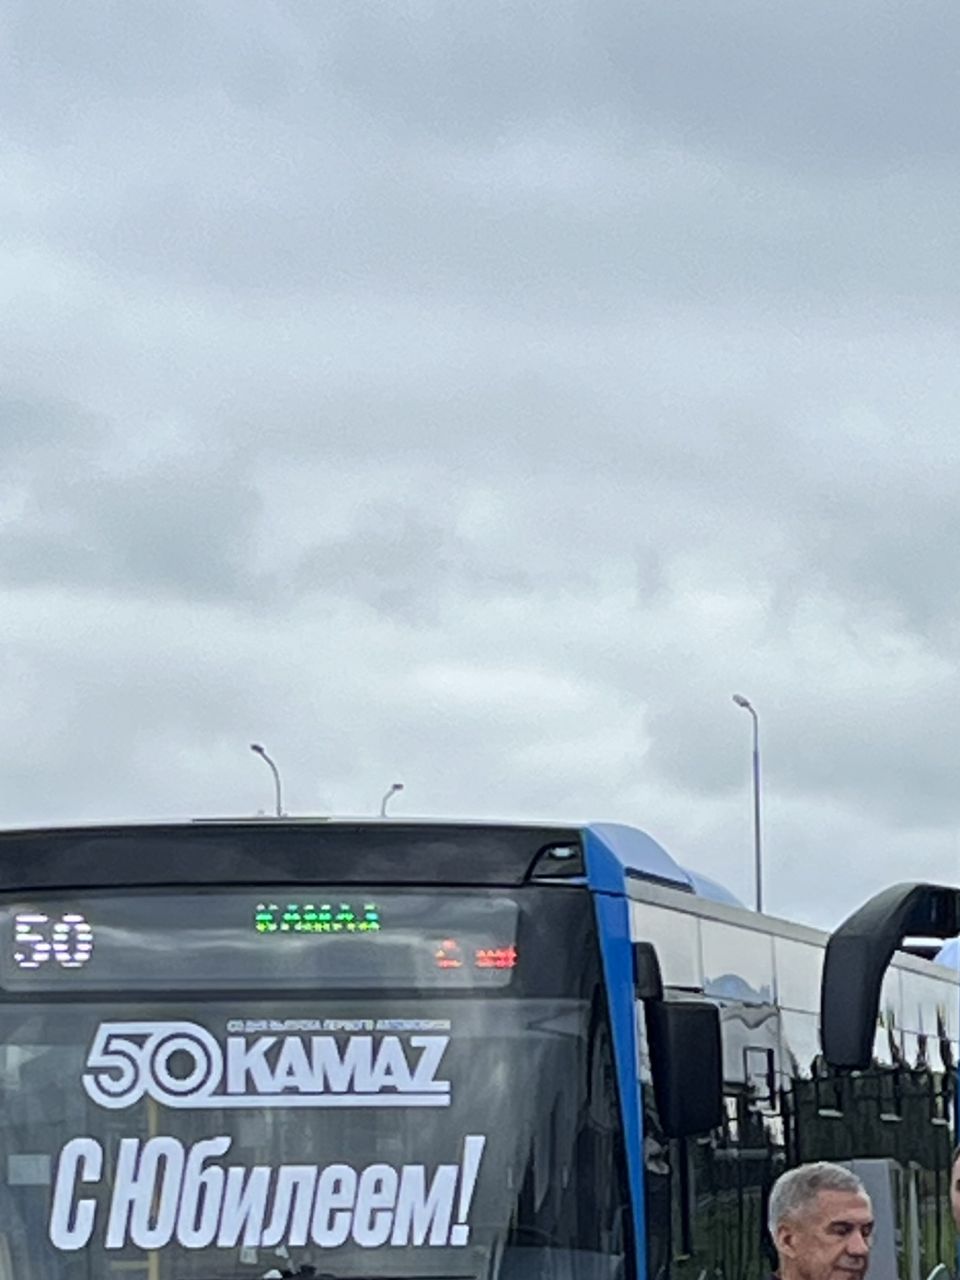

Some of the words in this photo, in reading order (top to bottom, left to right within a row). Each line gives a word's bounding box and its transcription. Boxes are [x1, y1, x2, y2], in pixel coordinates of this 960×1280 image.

[14, 914, 93, 968] 50
[82, 1021, 223, 1109] 50
[226, 1035, 451, 1093] KAMAZ
[49, 1137, 102, 1251] С
[105, 1135, 486, 1249] Юбилеем!
